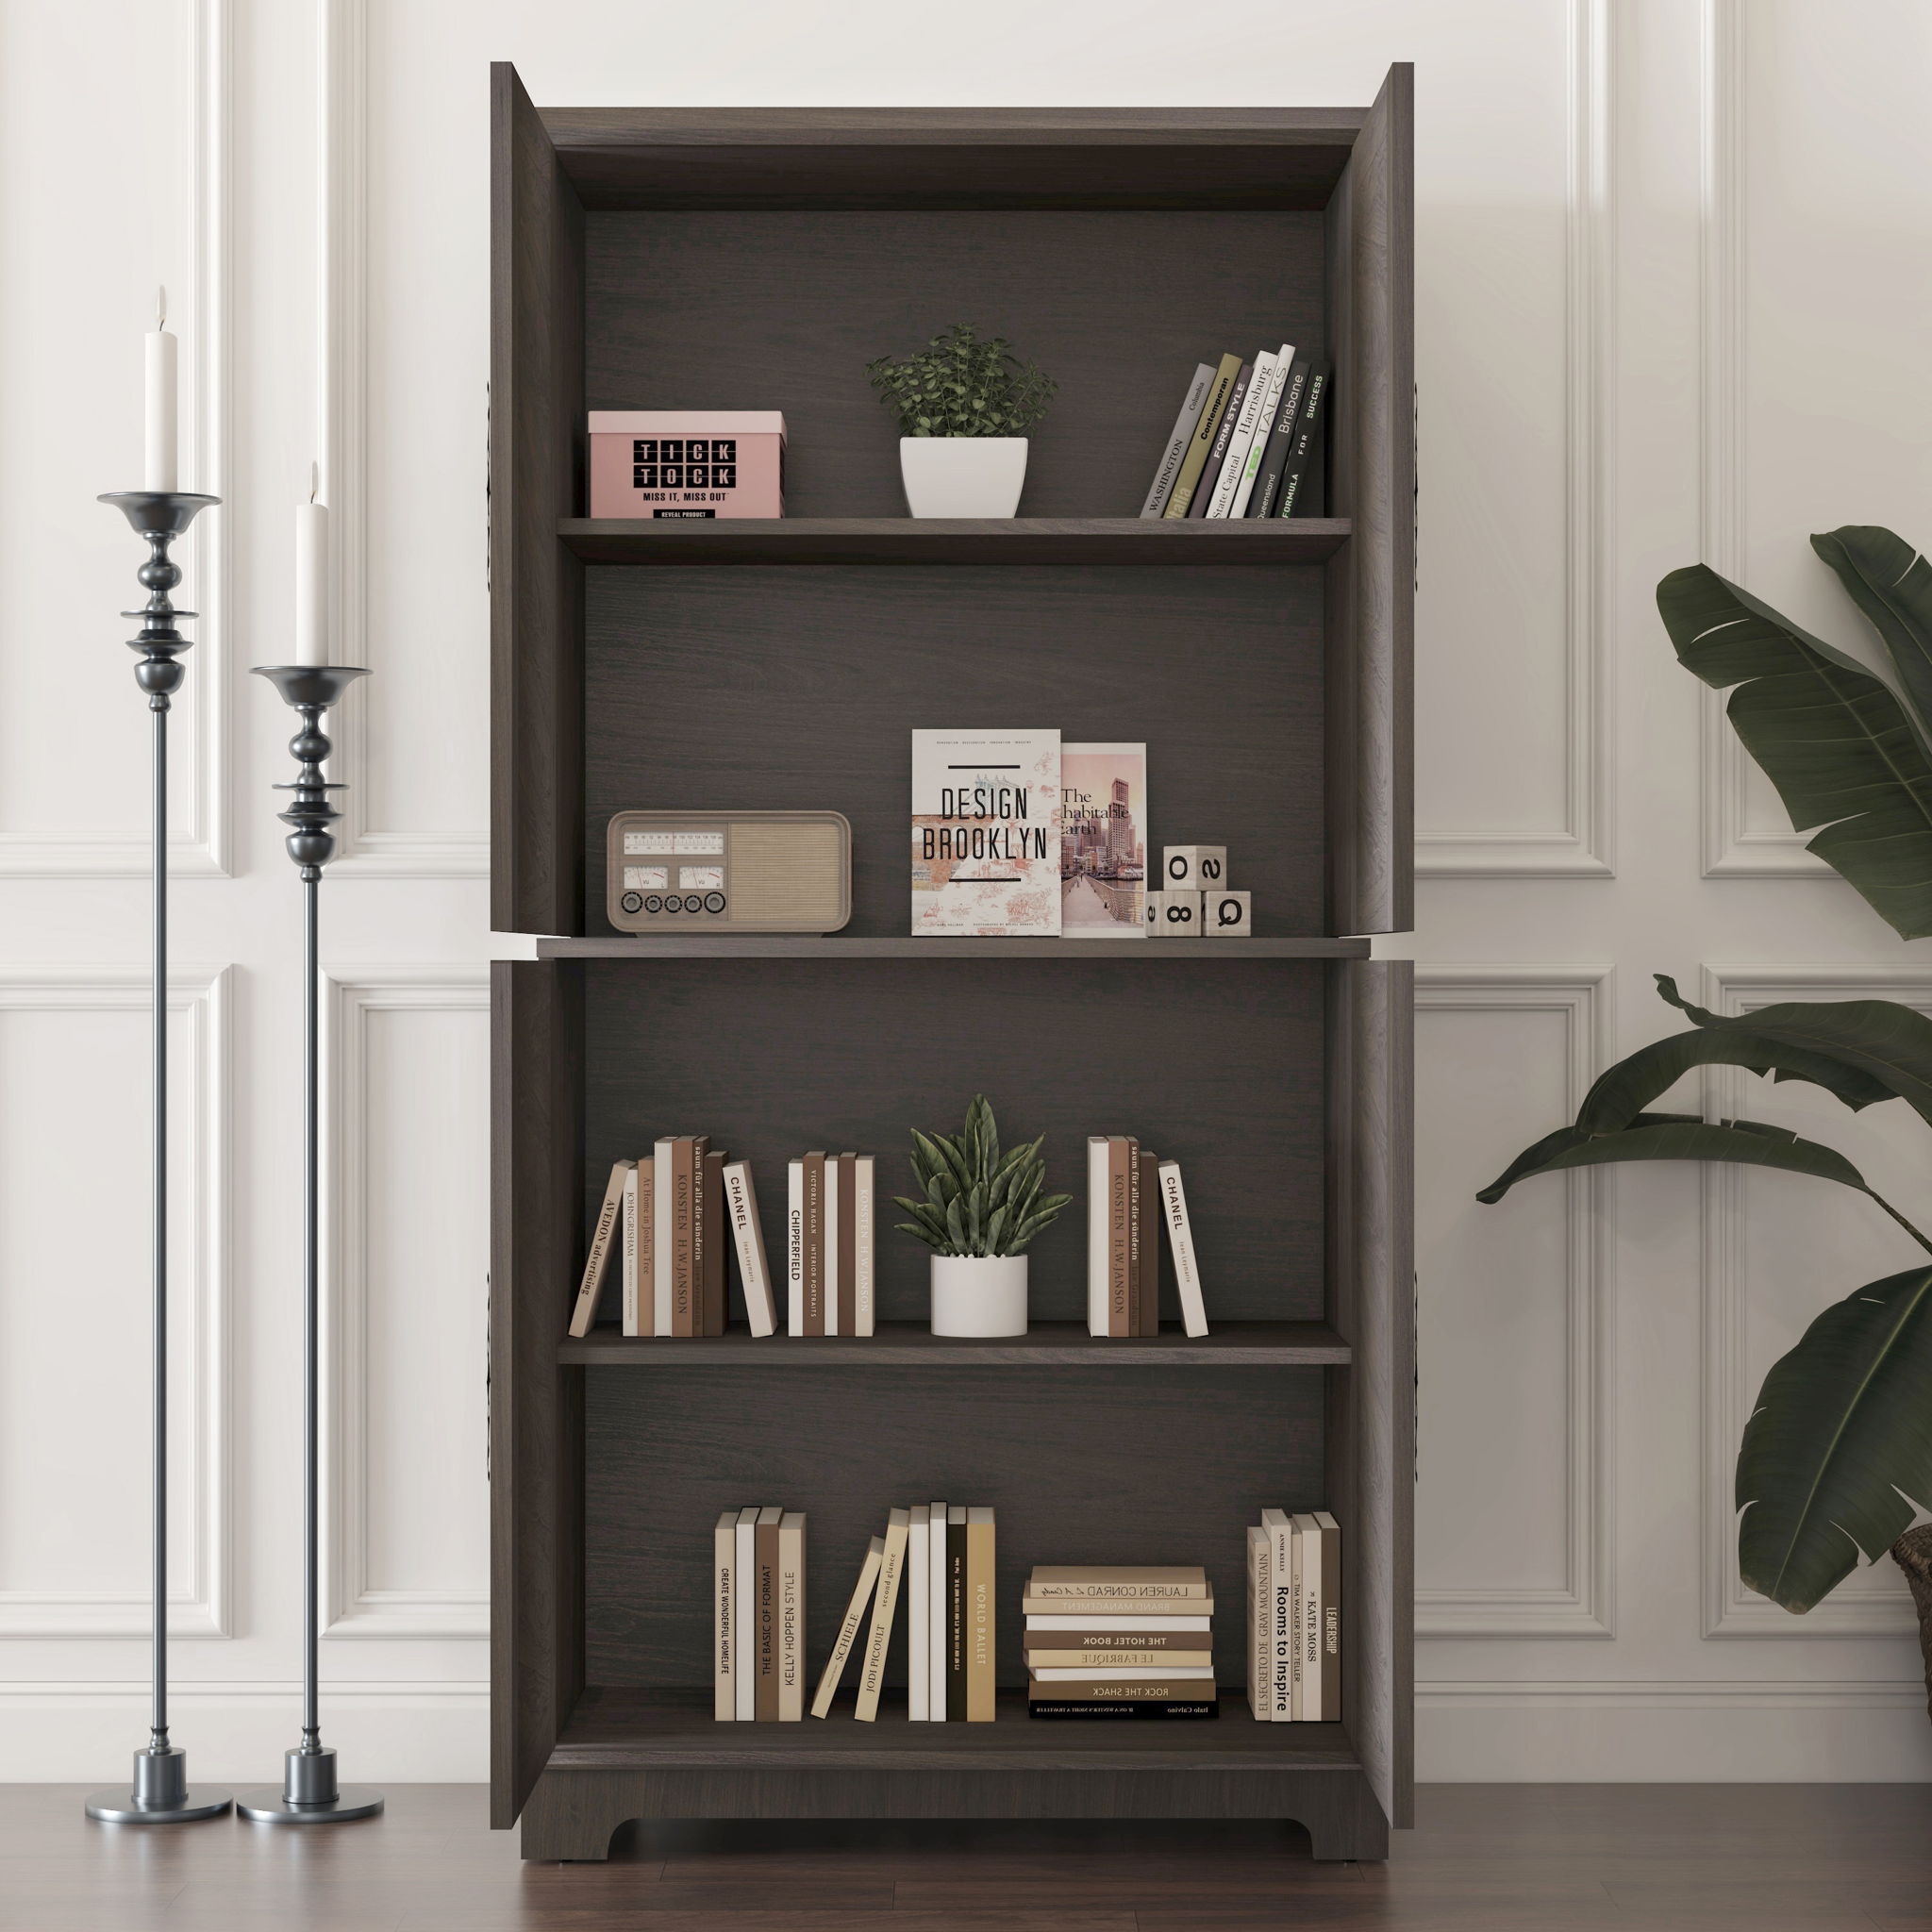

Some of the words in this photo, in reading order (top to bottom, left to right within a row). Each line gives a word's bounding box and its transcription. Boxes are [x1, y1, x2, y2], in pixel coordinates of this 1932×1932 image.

[1200, 377, 1230, 441] Contemporan
[1213, 423, 1231, 458] FORM
[1226, 382, 1245, 421] STYLE
[1278, 375, 1303, 434] Brisbane
[1212, 493, 1227, 519] State
[1223, 455, 1241, 491] Capital
[1238, 365, 1272, 435] Harrisburg
[1244, 445, 1261, 481] TED
[1257, 367, 1287, 436] TALKS
[641, 443, 729, 459] TICK
[1149, 440, 1183, 511] WASHINGTON
[1189, 382, 1205, 410] Columbia
[1282, 474, 1299, 519] FORMULA
[1298, 434, 1307, 455] FOR
[1307, 375, 1323, 418] SUCCESS
[641, 468, 729, 484] TOCK
[643, 492, 665, 501] MISS
[669, 492, 679, 502] IT,
[683, 492, 706, 501] MISS
[941, 788, 1027, 820] DESIGN
[1061, 789, 1091, 802] The
[923, 827, 1046, 859] BROOKLYN
[643, 1176, 652, 1187] At
[643, 1189, 652, 1213] Home
[643, 1215, 651, 1224] in
[677, 1174, 688, 1230] KONSTEN
[694, 1206, 703, 1219] die
[730, 1176, 747, 1230] CHANEL
[859, 1189, 869, 1239] KONSTEN
[1114, 1174, 1124, 1230] KONSTEN
[1166, 1176, 1183, 1230] CHANEL
[593, 1199, 615, 1243] AVEDON
[641, 1225, 652, 1254] Joshua
[694, 1222, 703, 1260] sünderin
[791, 1209, 800, 1281] CHIPPERFIELD
[580, 1244, 602, 1295] advertising
[721, 1568, 729, 1594] CREATE
[762, 1565, 771, 1606] FORMAT
[785, 1572, 794, 1603] STYLE
[882, 1580, 891, 1607] second
[887, 1553, 896, 1578] glance
[1258, 1554, 1268, 1607] MOUNTAIN
[721, 1595, 729, 1638] WONDERFUL
[762, 1608, 771, 1623] OF
[976, 1584, 986, 1623] WORLD
[1258, 1608, 1268, 1637] GRAY
[1277, 1587, 1289, 1635] Rooms
[1307, 1600, 1316, 1629] KATE
[762, 1625, 772, 1654] BASIC
[785, 1607, 794, 1650] HOPPEN
[836, 1613, 859, 1662] SCHIELE
[870, 1624, 885, 1668] PICOULT
[976, 1627, 986, 1664] BALLET
[1307, 1631, 1316, 1663] MOSS
[1325, 1607, 1338, 1654] LEADERSHIP
[721, 1641, 729, 1674] HOMELIFE
[762, 1657, 771, 1675] THE
[1258, 1642, 1268, 1655] DE
[1277, 1639, 1289, 1657] to
[785, 1653, 794, 1686] KELLY
[866, 1670, 877, 1692] JODI
[1258, 1657, 1268, 1698] SECRETO
[1274, 1660, 1290, 1711] Inspire
[1258, 1702, 1268, 1711] EL
